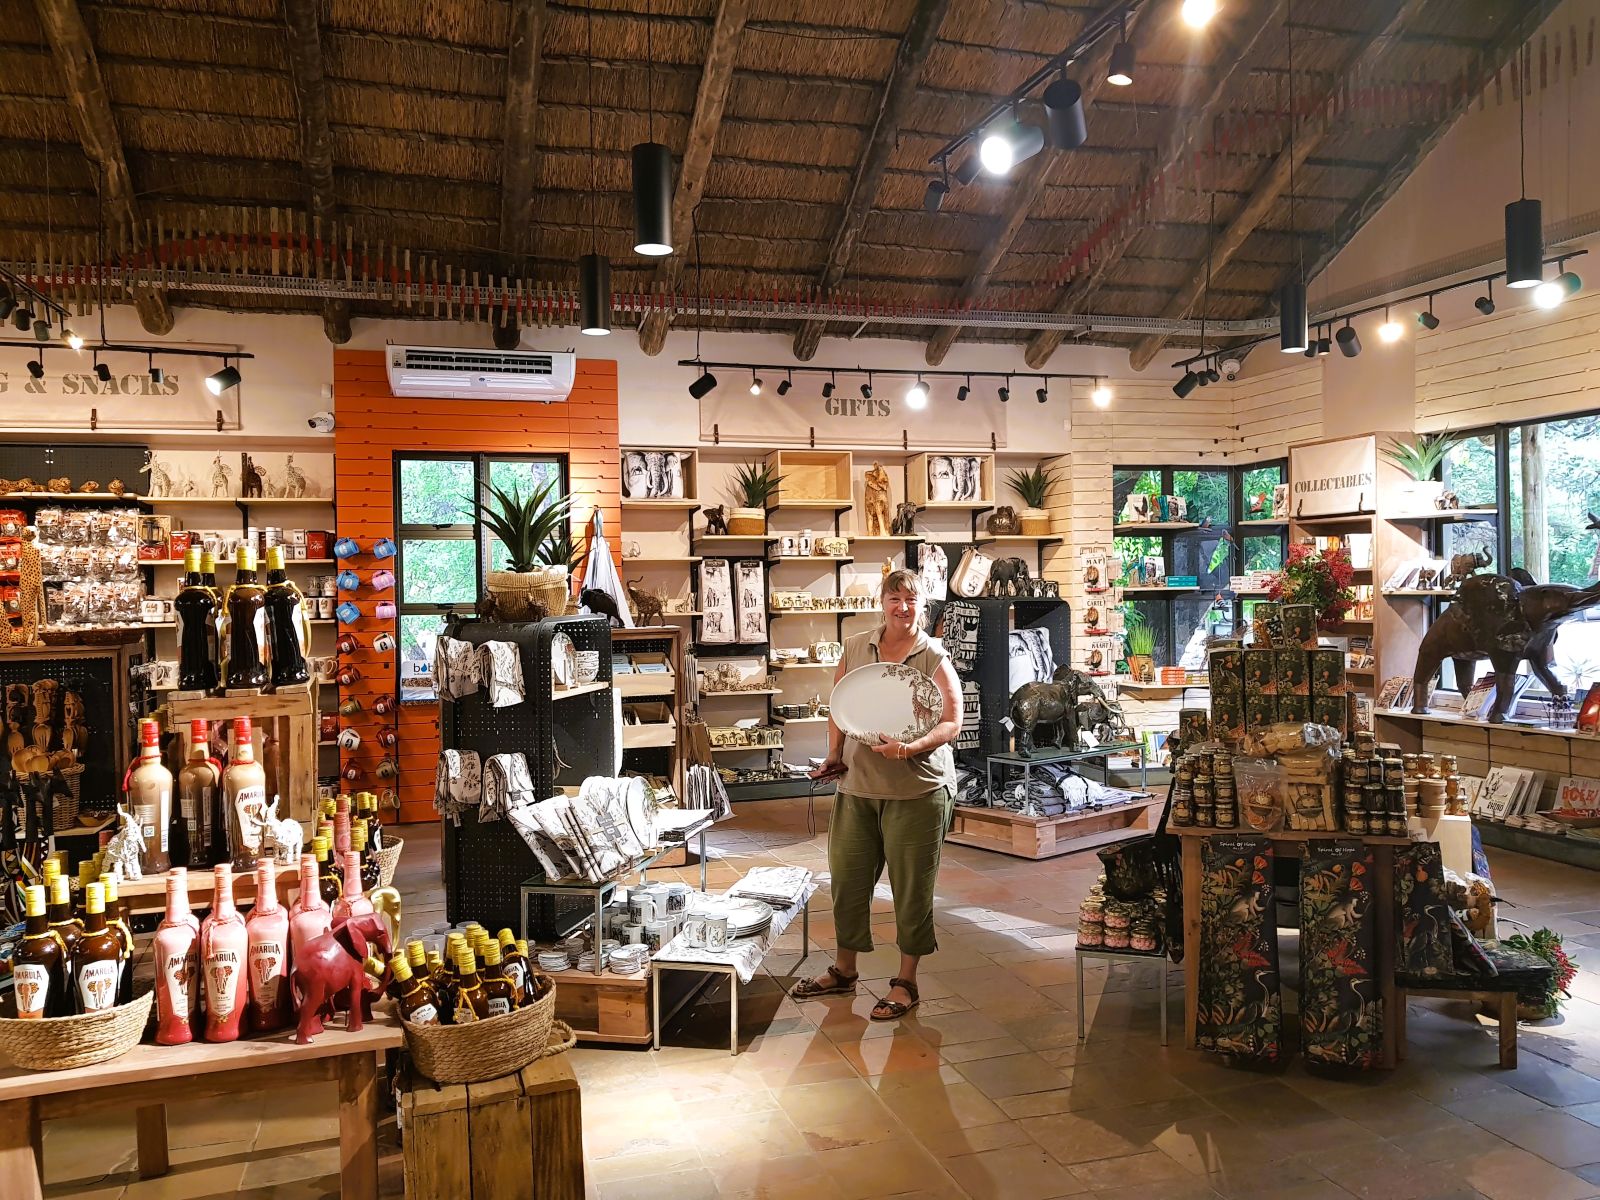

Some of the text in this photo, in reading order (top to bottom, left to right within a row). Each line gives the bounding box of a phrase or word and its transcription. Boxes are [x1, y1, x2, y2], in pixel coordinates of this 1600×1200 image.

[24, 375, 48, 394] &
[62, 373, 179, 396] SNACKS
[825, 398, 890, 416] GIFTS
[1294, 472, 1372, 493] COLLECTABLES
[250, 943, 280, 957] AMARULA
